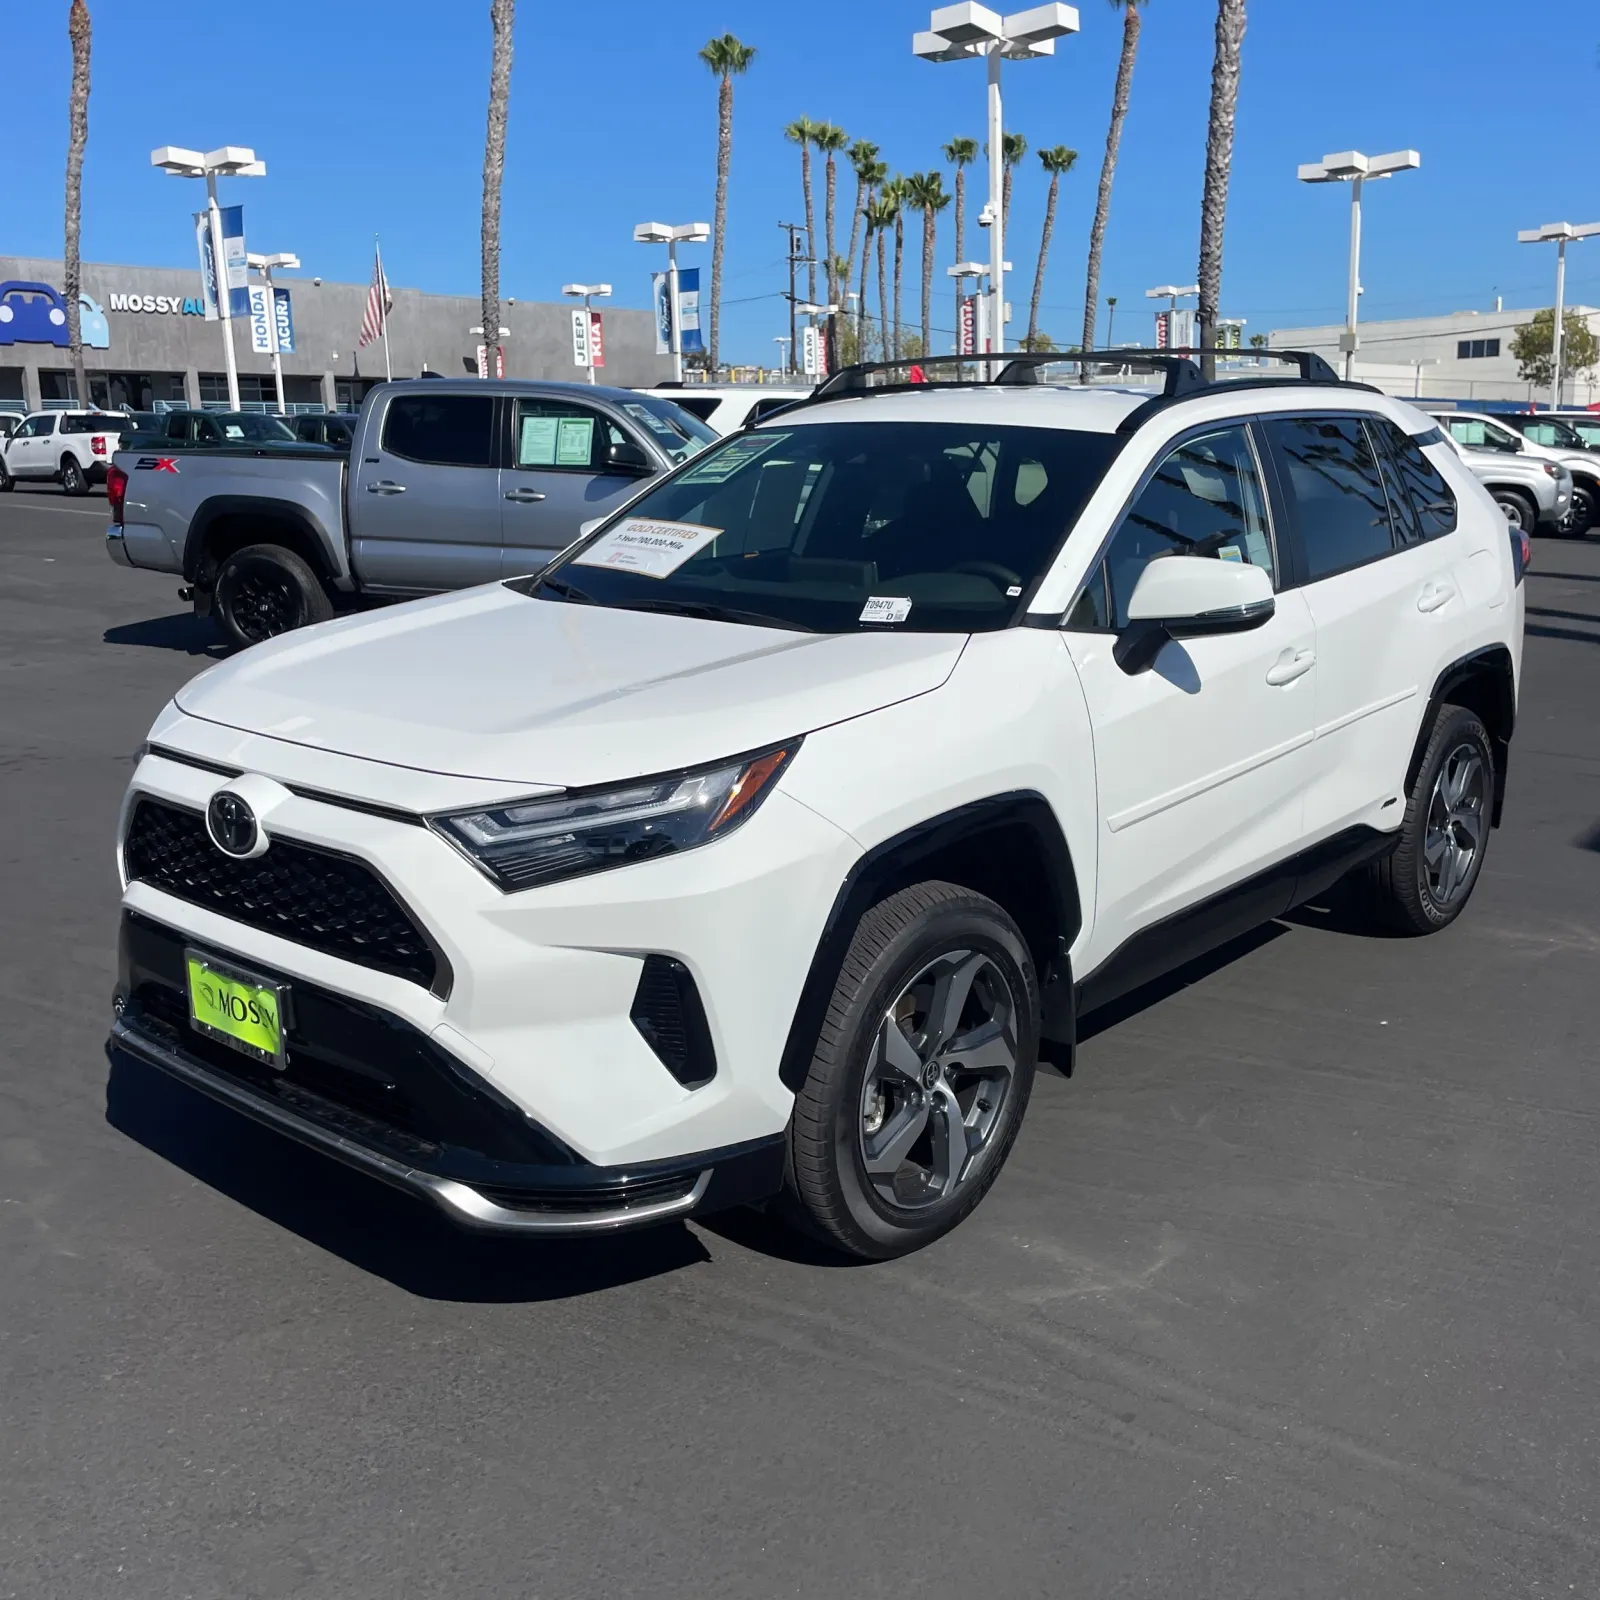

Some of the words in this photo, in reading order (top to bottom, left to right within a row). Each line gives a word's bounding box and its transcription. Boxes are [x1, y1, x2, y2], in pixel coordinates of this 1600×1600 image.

[109, 293, 181, 314] MOSSY
[182, 296, 205, 315] AU
[252, 291, 268, 348] HONDA
[276, 294, 292, 351] ACURA
[575, 316, 586, 362] JEEP
[591, 322, 602, 356] KIA
[963, 298, 975, 356] TOYOTA
[1157, 314, 1169, 349] YOTA
[626, 524, 653, 534] GOLD
[652, 525, 699, 540] CERTIFIED
